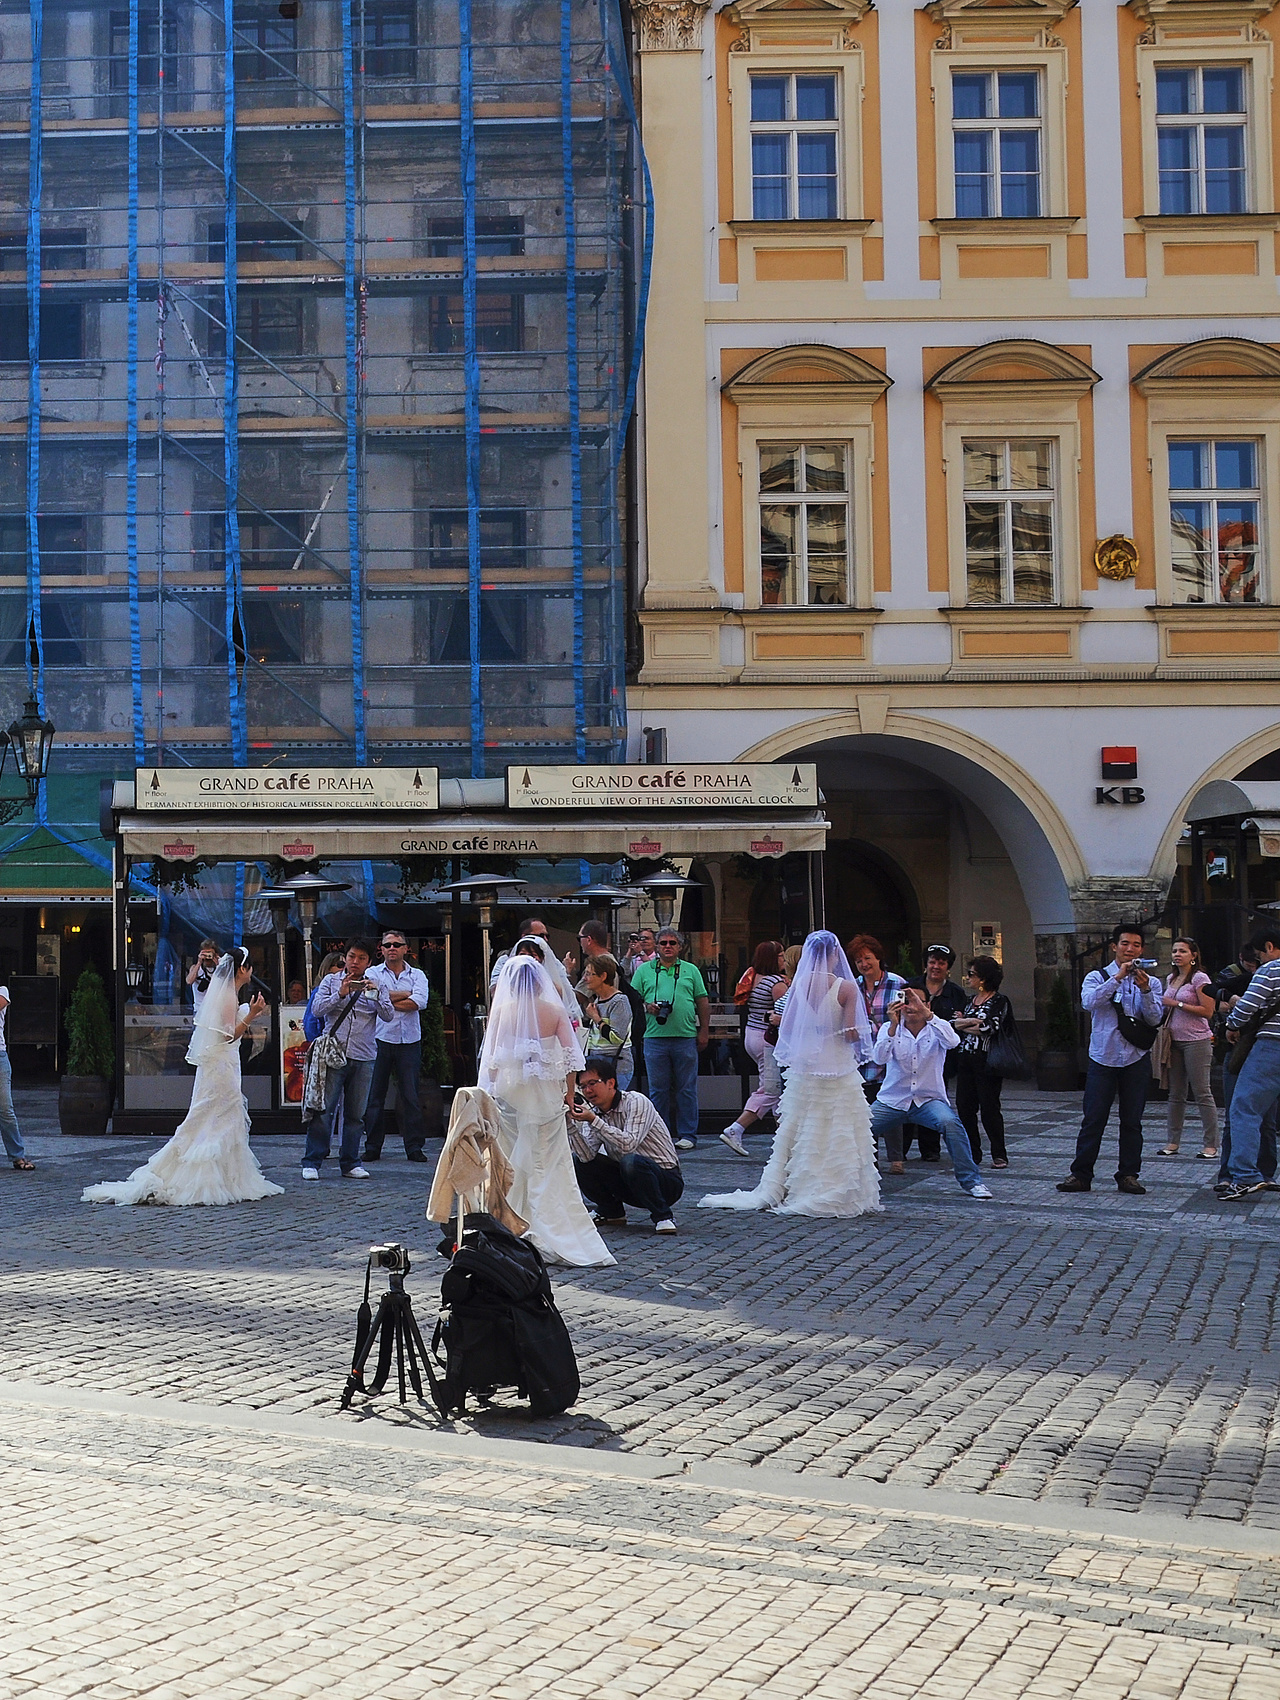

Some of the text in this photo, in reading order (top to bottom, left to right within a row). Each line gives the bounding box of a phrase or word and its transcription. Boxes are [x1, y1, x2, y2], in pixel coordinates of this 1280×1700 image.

[199, 773, 374, 790] GRAND café PRAHA
[572, 770, 752, 788] GRAND café PRAHA
[530, 795, 794, 805] WONDERFUL VIEW OF THE ASTRONOMICAL CLOCK
[1095, 786, 1146, 804] KB
[400, 836, 538, 851] GRAND café PRAHA
